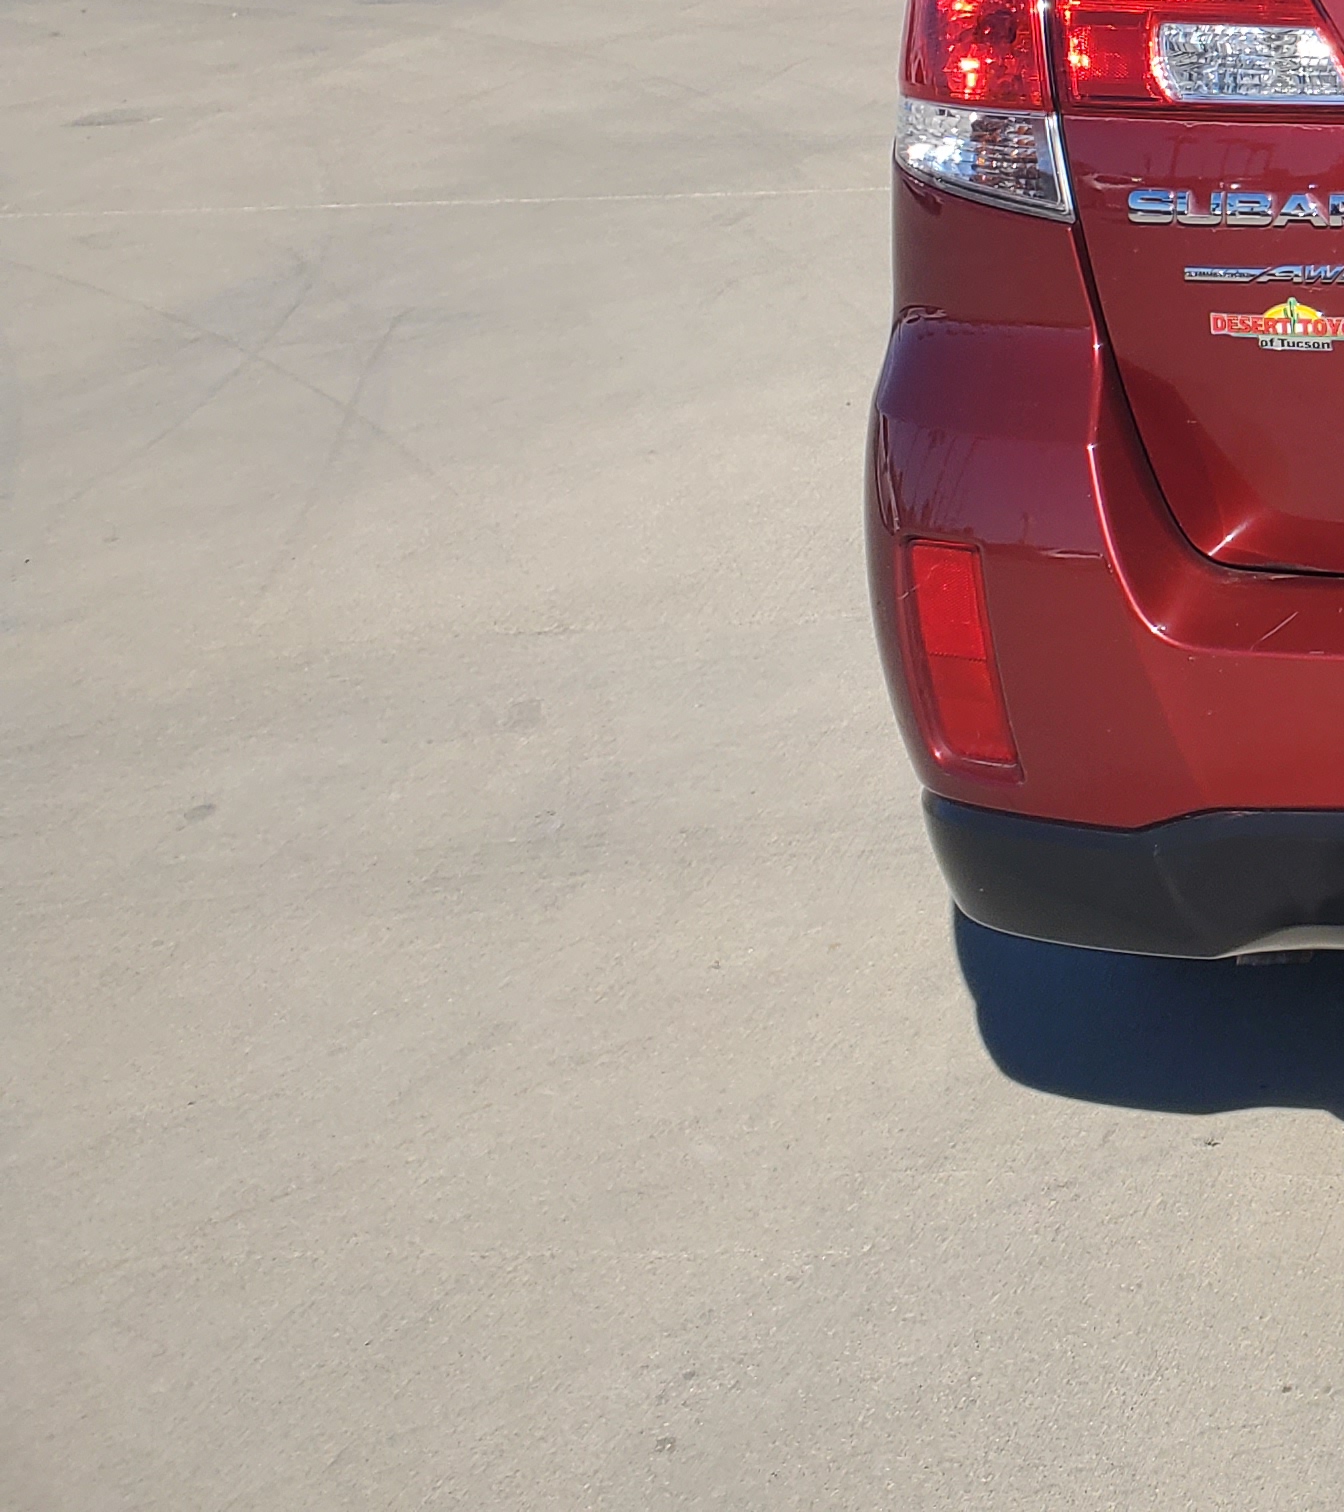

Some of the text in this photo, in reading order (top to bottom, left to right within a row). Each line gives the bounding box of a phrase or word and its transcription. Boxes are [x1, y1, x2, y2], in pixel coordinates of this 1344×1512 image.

[1212, 315, 1291, 335] DESERT
[1260, 338, 1331, 349] of Tucson
